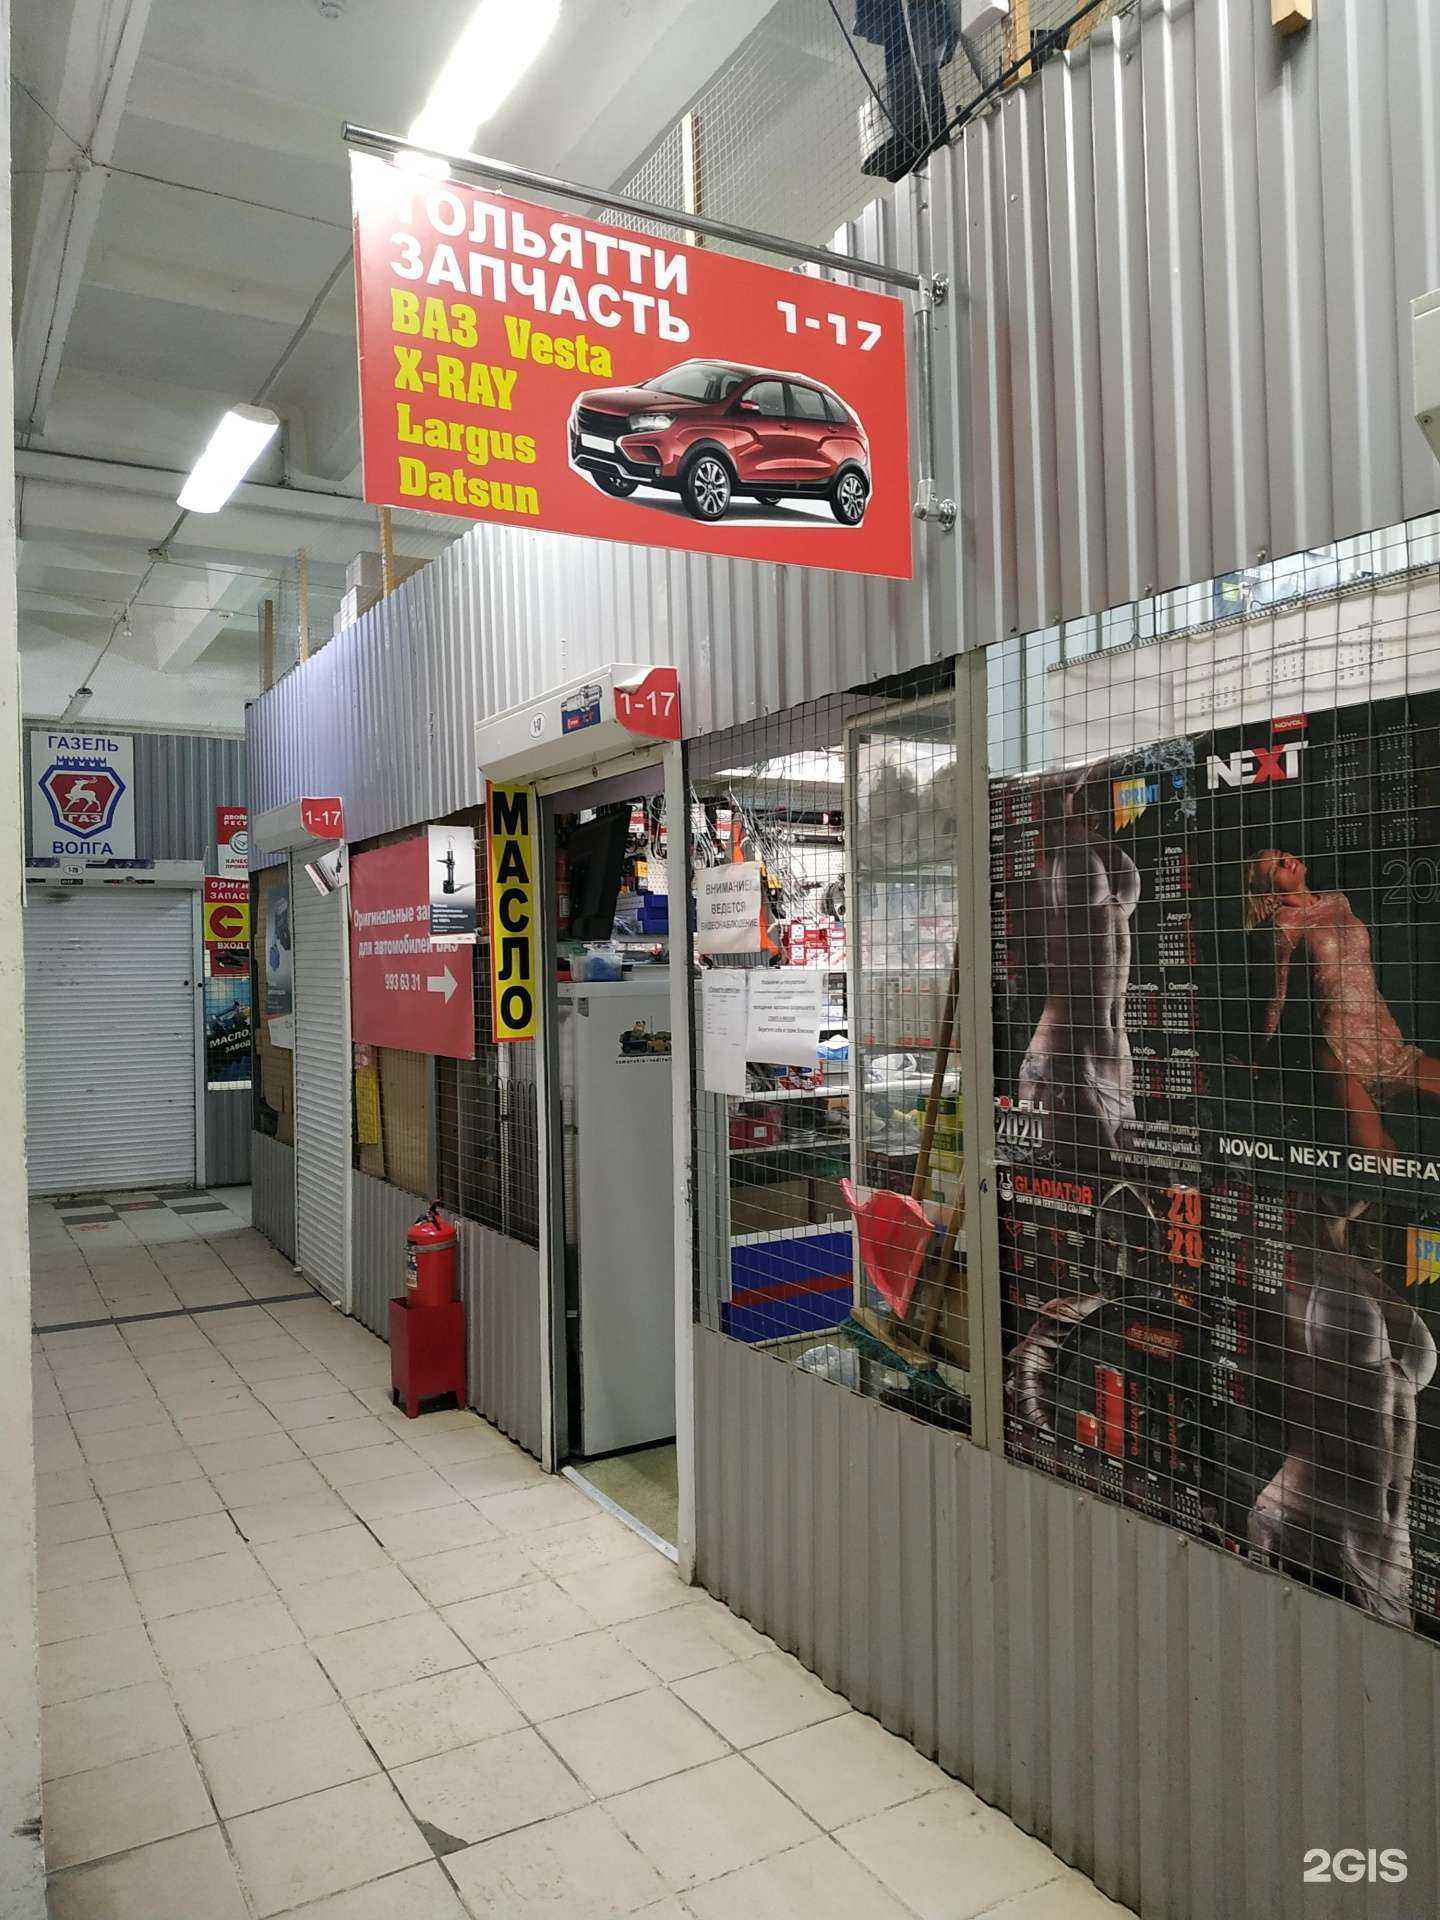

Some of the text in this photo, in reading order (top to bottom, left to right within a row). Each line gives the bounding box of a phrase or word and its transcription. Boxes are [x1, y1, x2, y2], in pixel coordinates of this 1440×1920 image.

[389, 233, 691, 343] ЗАПЧАСТЬ
[390, 288, 613, 378] ВАЗ Vesta
[776, 300, 882, 353] 1-17
[393, 345, 518, 411] X-RAY
[396, 403, 537, 466] Largus
[398, 456, 540, 516] Datsun
[621, 691, 675, 717] 1-17
[48, 735, 119, 752] ГАЗЕЛЬ
[1206, 740, 1309, 789] NEXT
[67, 814, 103, 824] ГАЗ
[305, 810, 341, 826] 1-17
[52, 841, 114, 855] ВОЛГА
[1382, 857, 1440, 905] 20
[354, 906, 415, 931] Оригинальные
[492, 791, 533, 1031] МАСЛО
[711, 901, 746, 915] ВЕДЕТСЯ
[217, 942, 244, 950] ВХОД
[359, 941, 373, 960] для
[209, 1028, 252, 1049] МАСЛО
[995, 1112, 1043, 1148] 2020
[1219, 1136, 1284, 1162] NOVOL.
[1290, 1146, 1342, 1169] NEXT
[1014, 1175, 1093, 1205] GLADIATOR
